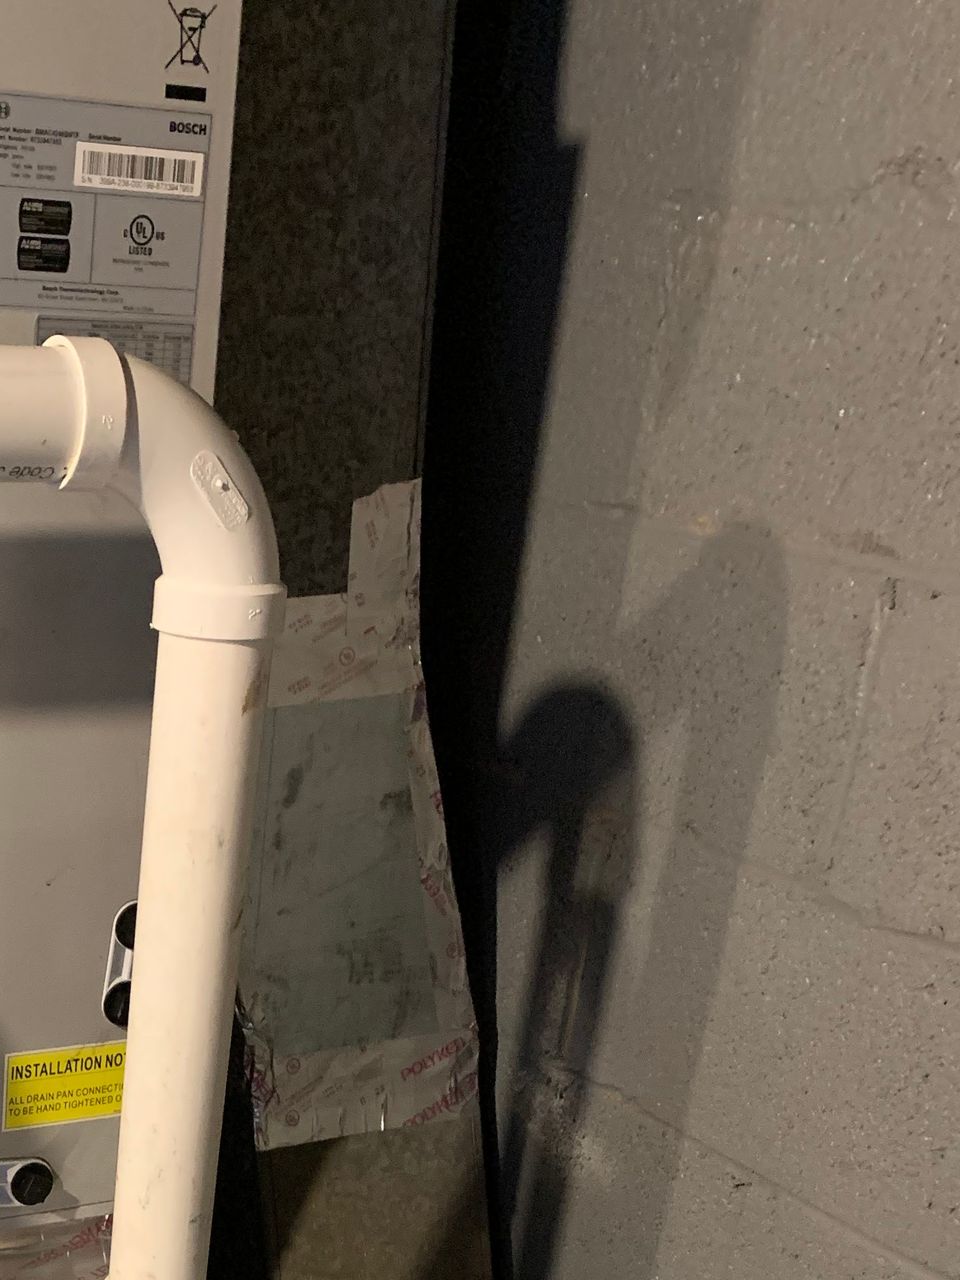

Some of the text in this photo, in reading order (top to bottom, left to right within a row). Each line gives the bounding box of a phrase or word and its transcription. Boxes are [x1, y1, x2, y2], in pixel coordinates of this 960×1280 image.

[169, 121, 207, 136] BOSCH
[128, 245, 153, 256] LISTED
[11, 1052, 127, 1080] INSTALLATION NO
[8, 1097, 25, 1106] ALL
[26, 1093, 54, 1104] DRAIN
[56, 1089, 74, 1099] PAN
[8, 1108, 21, 1117] TO
[22, 1106, 34, 1115] BE
[36, 1103, 61, 1113] HAND
[63, 1095, 113, 1109] TIGHTENED
